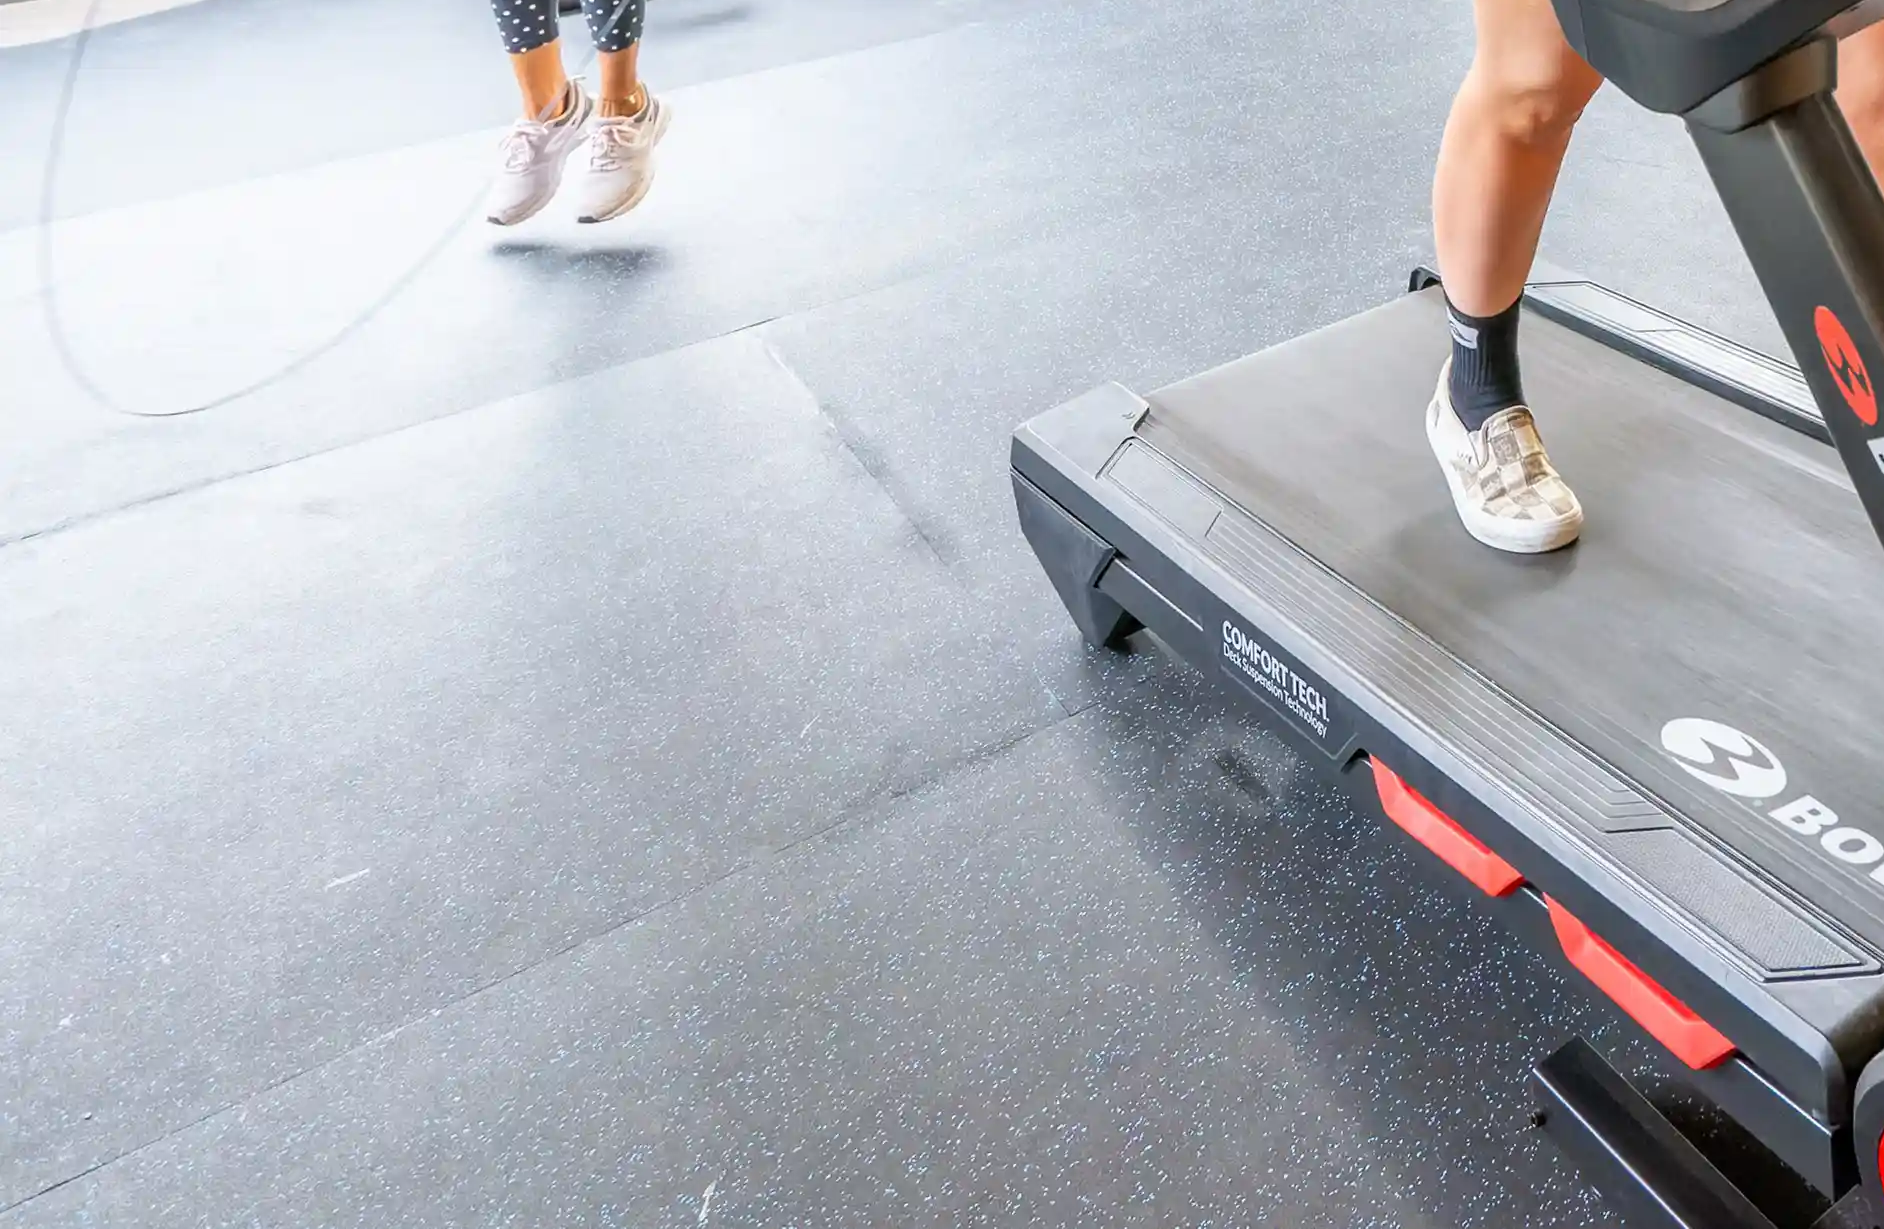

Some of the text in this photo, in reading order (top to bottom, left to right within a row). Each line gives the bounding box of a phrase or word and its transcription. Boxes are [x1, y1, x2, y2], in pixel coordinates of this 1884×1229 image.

[1222, 620, 1289, 688] COMFORT
[1223, 641, 1329, 739] Deck Suspension Technology
